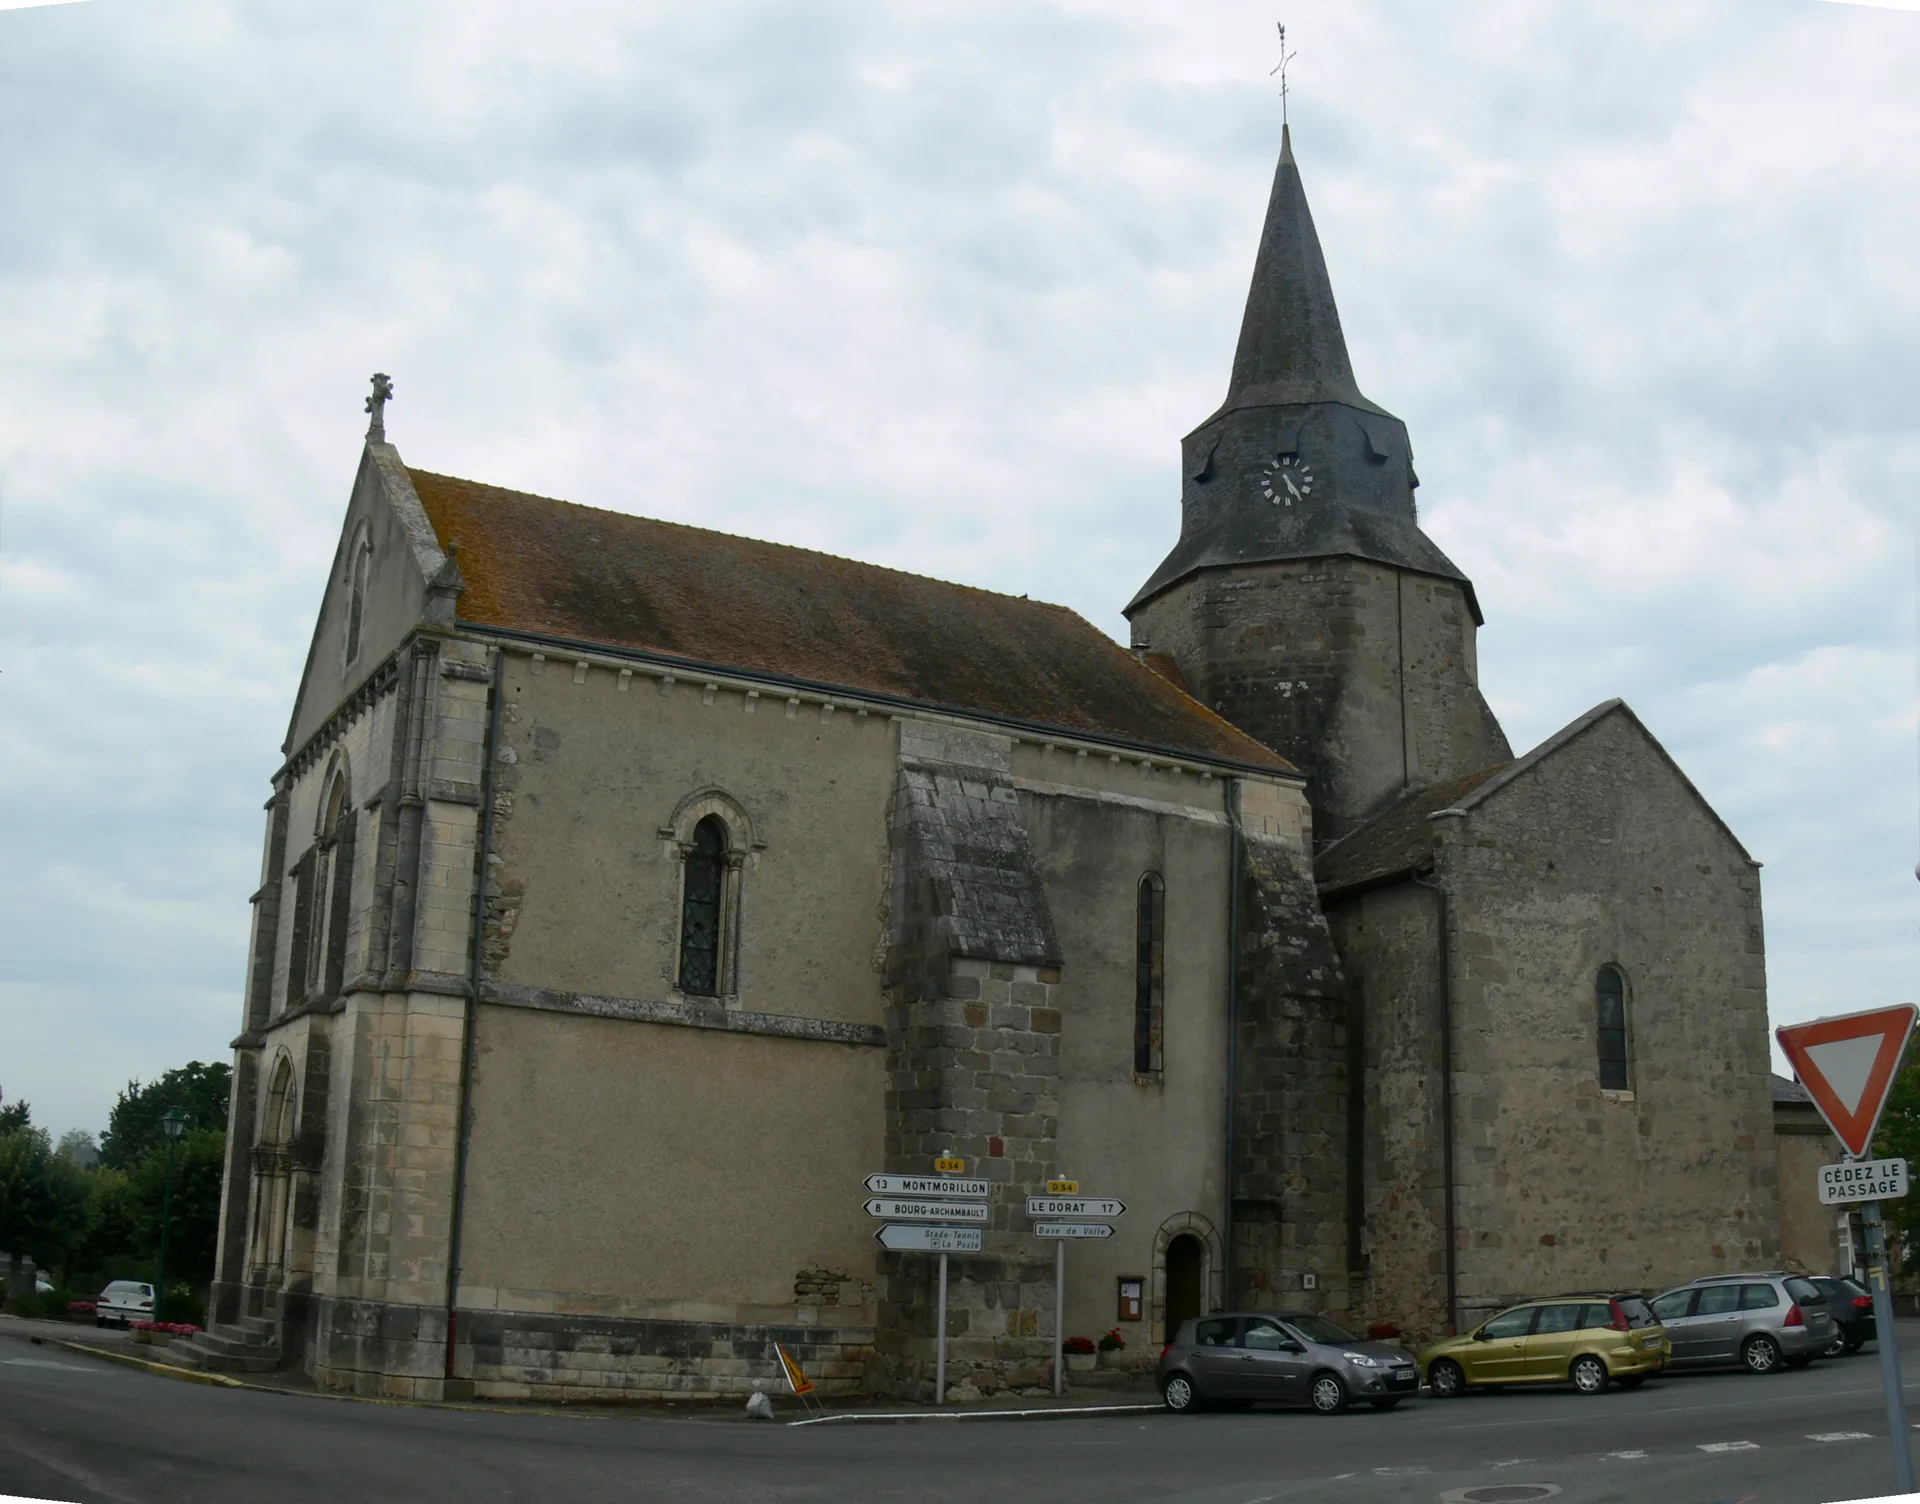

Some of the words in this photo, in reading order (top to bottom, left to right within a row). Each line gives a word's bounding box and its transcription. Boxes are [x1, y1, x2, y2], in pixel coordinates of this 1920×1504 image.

[948, 1160, 959, 1170] 54
[1824, 1167, 1873, 1183] CÉDEZ
[1882, 1163, 1900, 1177] LE
[875, 1179, 888, 1189] 13
[903, 1181, 985, 1193] MONTMORILLON
[1828, 1180, 1897, 1198] PASSAGE
[875, 1203, 882, 1213] 8
[895, 1204, 984, 1217] BOURG-ARCHAMBAULT
[1032, 1202, 1045, 1212] LE
[1049, 1203, 1085, 1212] DORAT
[1101, 1203, 1114, 1213] 17
[1038, 1226, 1060, 1235] Base
[1066, 1227, 1077, 1235] de
[1083, 1227, 1106, 1235] Voile
[942, 1240, 952, 1248] La
[956, 1240, 979, 1249] Poste
